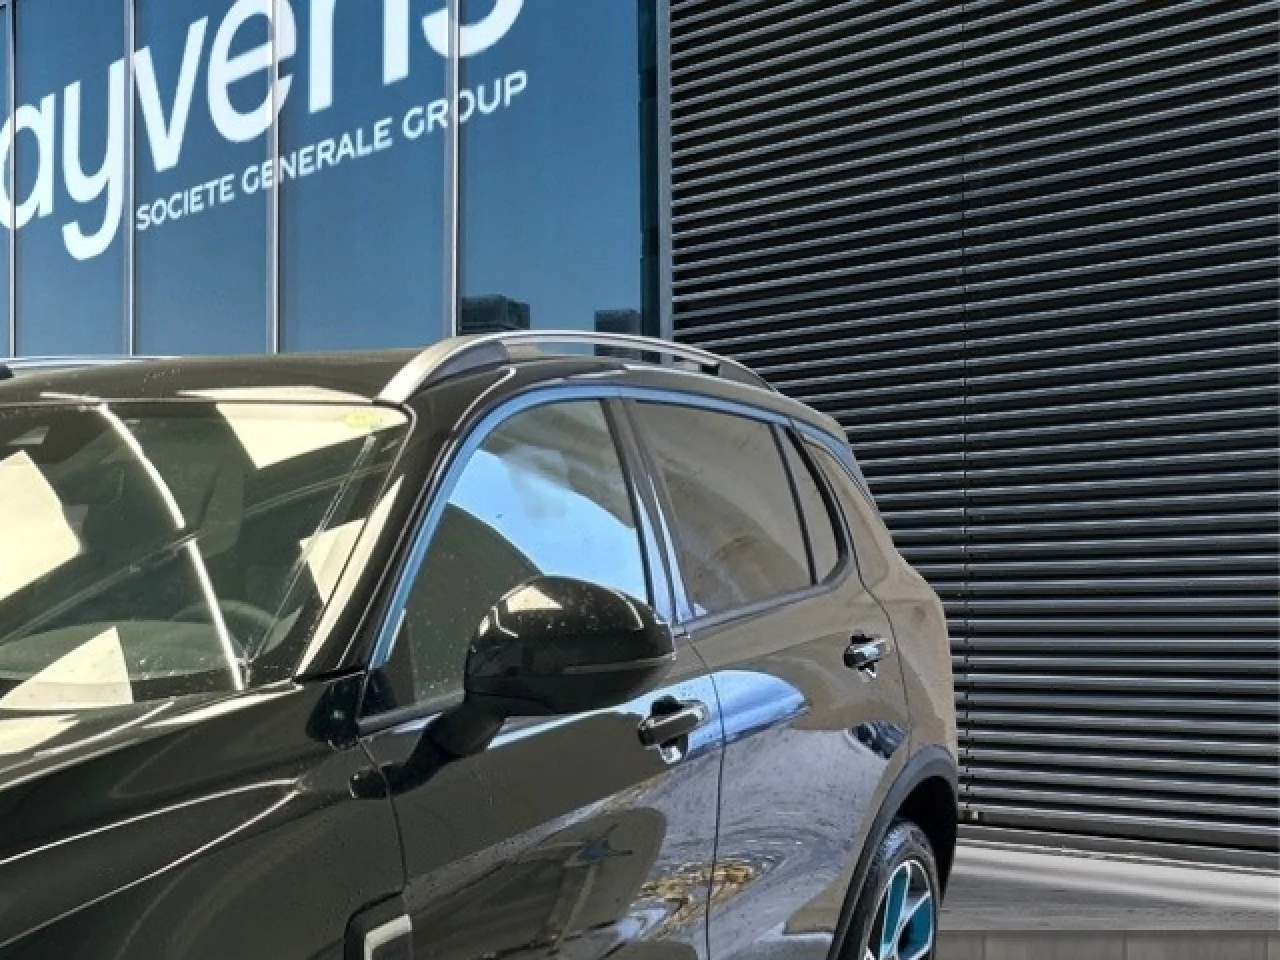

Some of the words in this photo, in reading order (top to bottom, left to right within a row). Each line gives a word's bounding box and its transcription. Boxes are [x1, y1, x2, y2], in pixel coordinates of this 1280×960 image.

[135, 173, 236, 231] SOCIETE
[241, 117, 394, 194] GENERALE
[402, 70, 527, 140] GROUP
